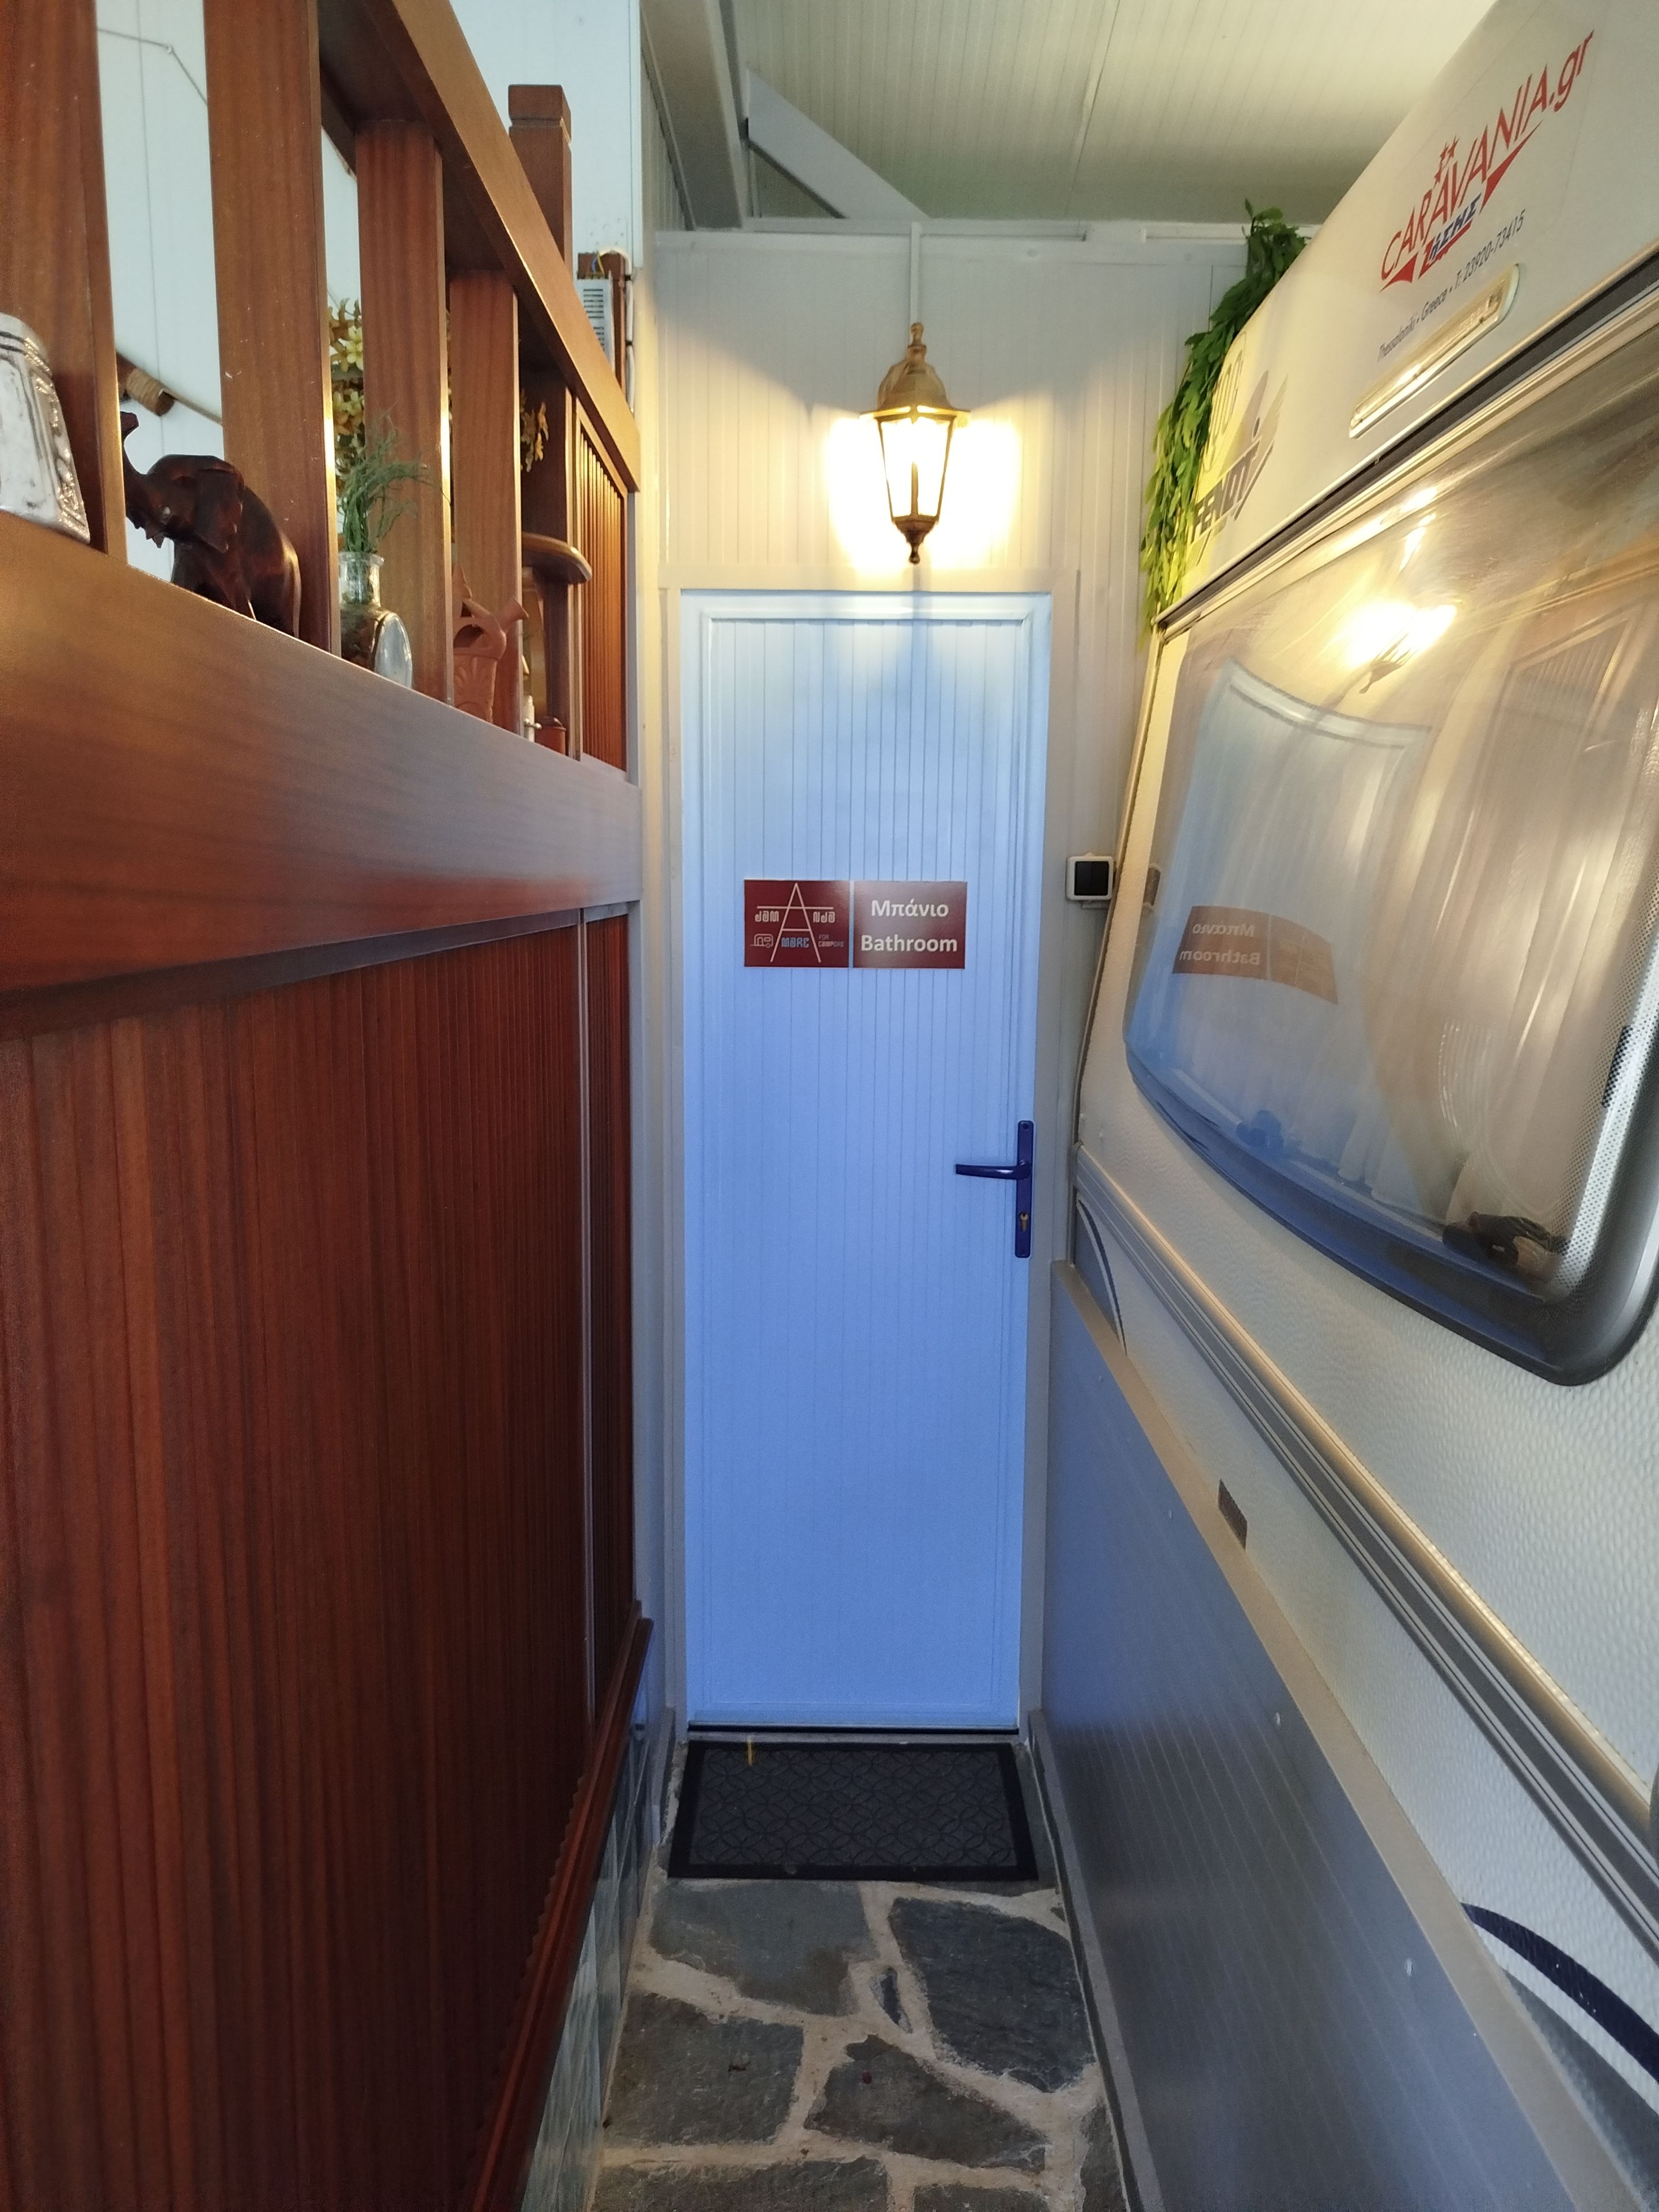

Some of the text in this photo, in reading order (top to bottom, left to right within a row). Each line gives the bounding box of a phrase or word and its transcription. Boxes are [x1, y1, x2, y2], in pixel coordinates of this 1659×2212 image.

[1381, 29, 1594, 281] CARAVANIA.gr
[1421, 289, 1448, 321] Greece
[1463, 209, 1525, 282] 23920-73415
[1190, 441, 1260, 544] FENDT
[861, 934, 957, 952] Bathroom
[871, 899, 949, 916] Μπάνιο
